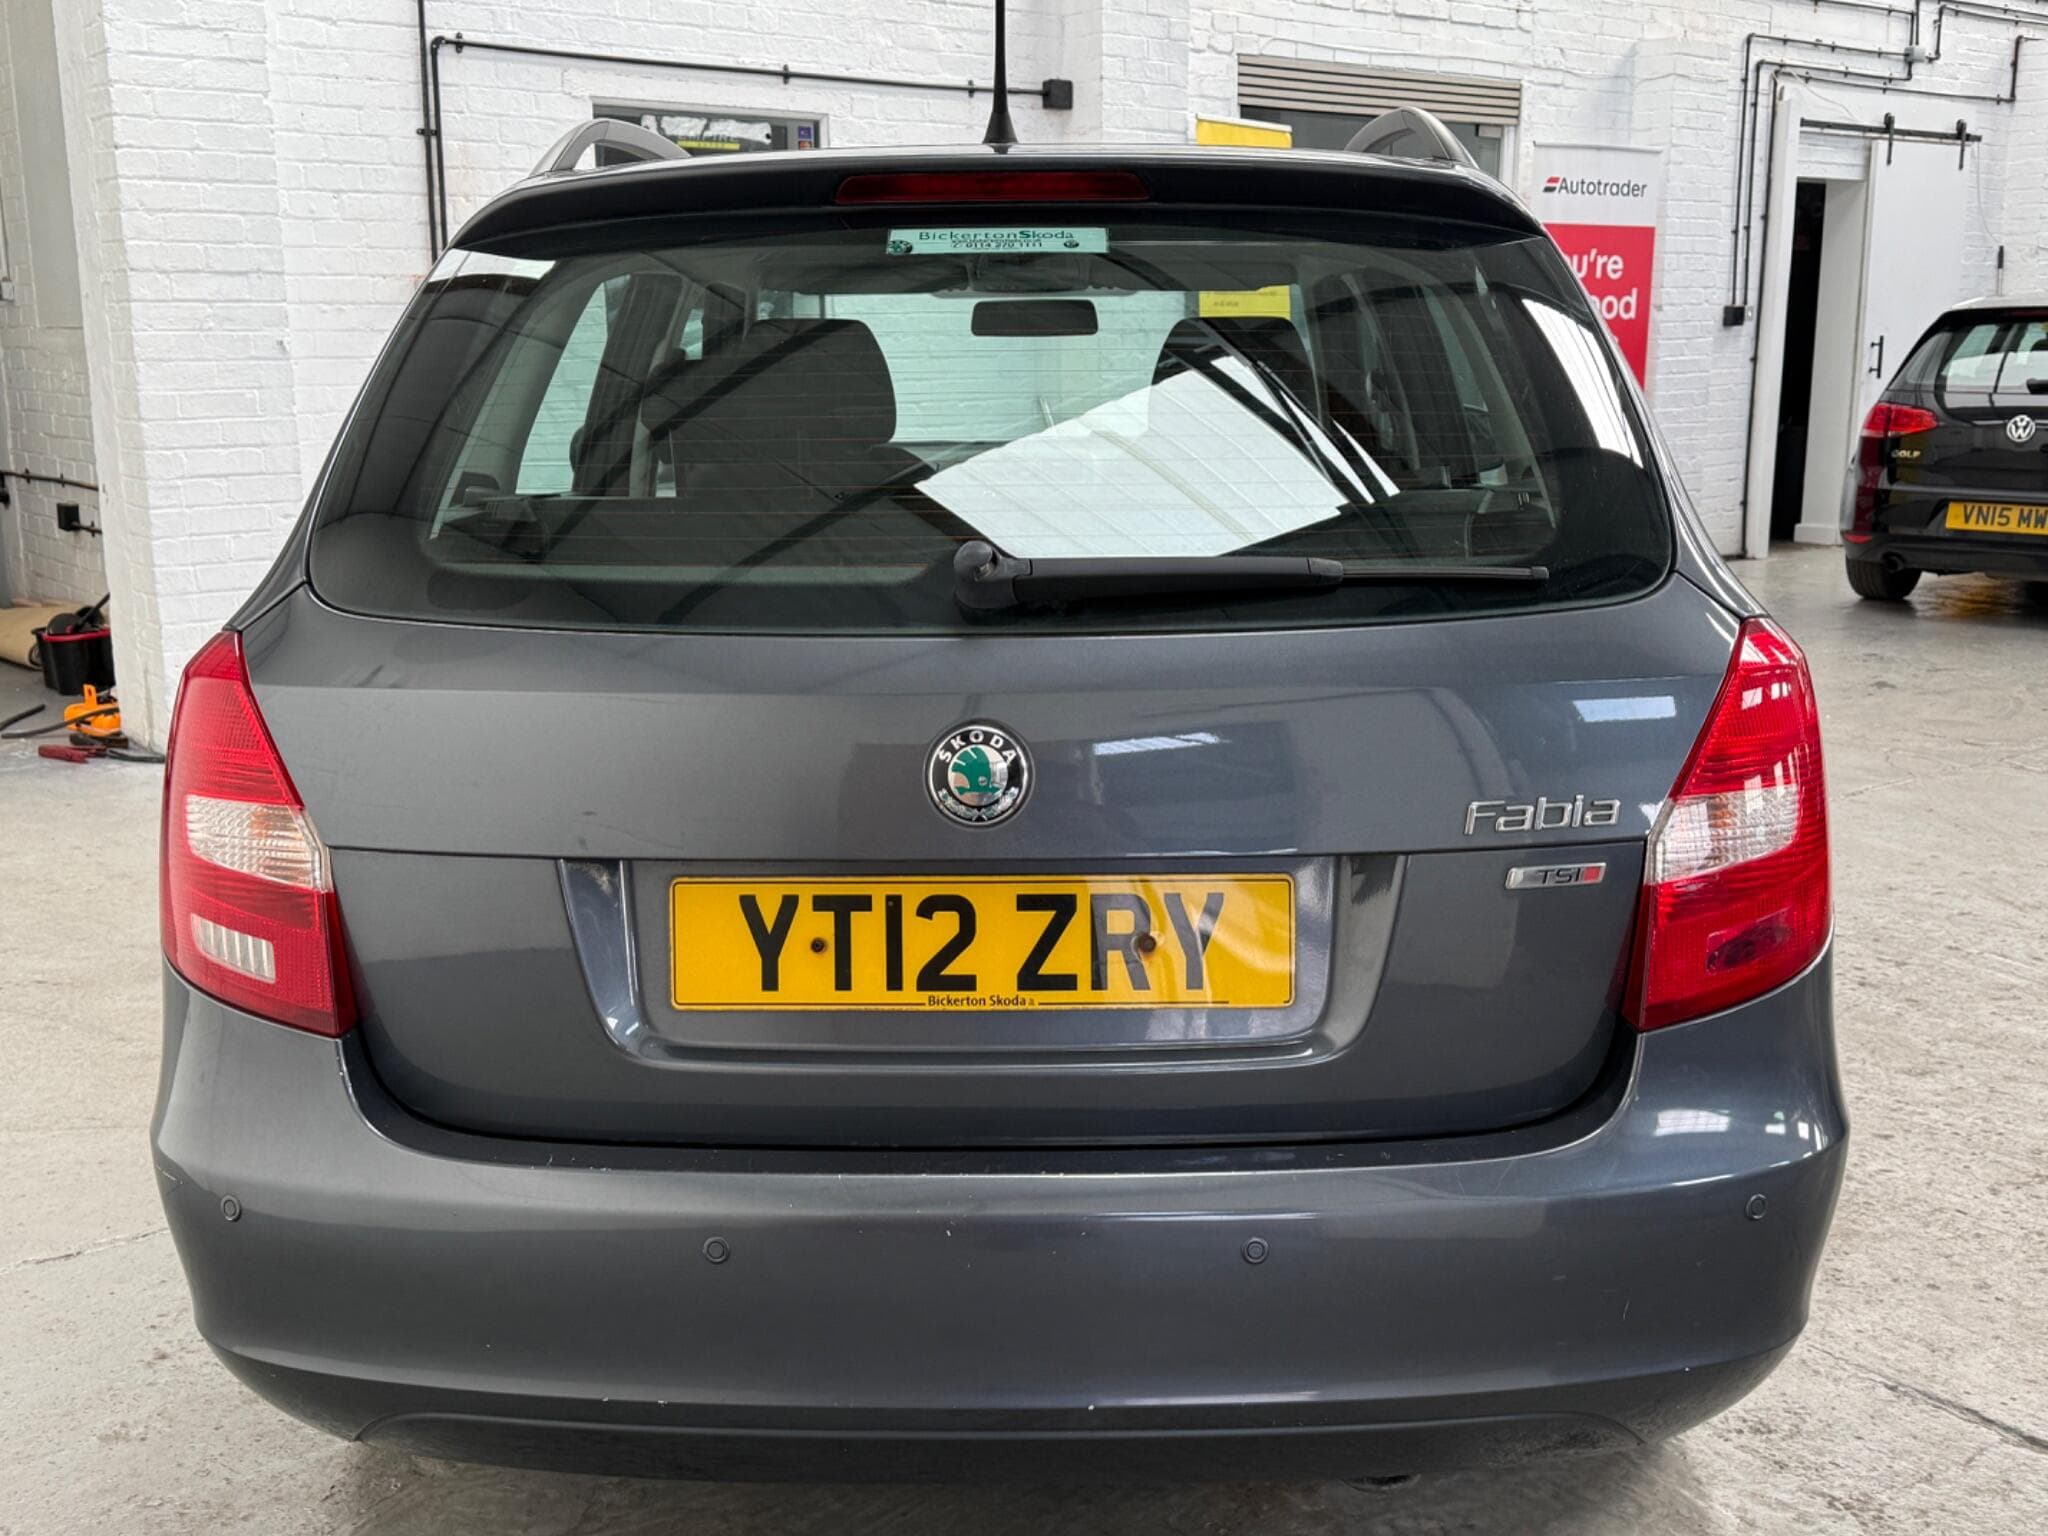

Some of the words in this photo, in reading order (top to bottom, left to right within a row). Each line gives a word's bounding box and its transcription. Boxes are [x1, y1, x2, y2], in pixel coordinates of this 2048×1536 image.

[1558, 177, 1648, 198] Autotrader
[1963, 504, 2012, 527] VN15
[1464, 795, 1621, 835] Fabia
[1539, 868, 1581, 885] TSI
[739, 893, 977, 993] YT12
[1016, 893, 1225, 992] ZRY
[927, 994, 986, 1007] Bickerton
[989, 994, 1027, 1007] Skoda
